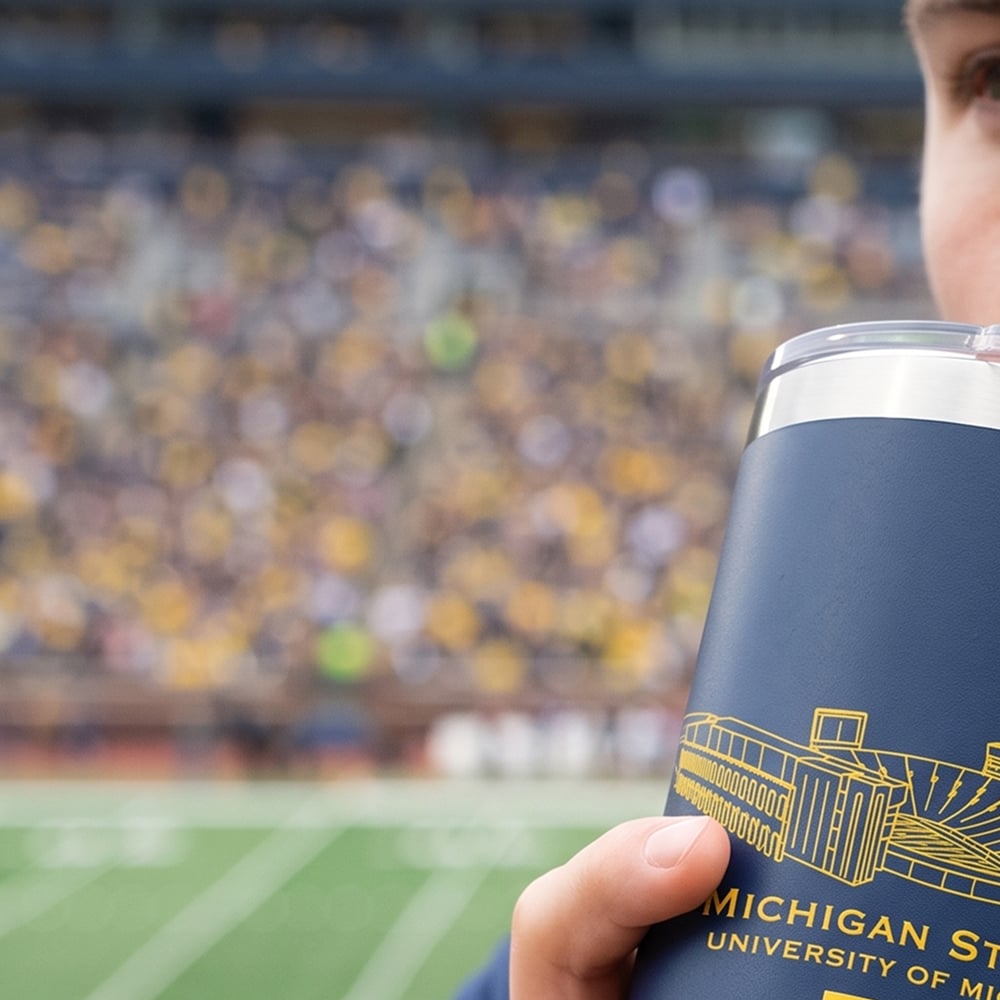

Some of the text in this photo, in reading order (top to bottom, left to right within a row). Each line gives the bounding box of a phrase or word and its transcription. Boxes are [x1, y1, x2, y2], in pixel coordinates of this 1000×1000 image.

[702, 888, 930, 952] MICHIGAN
[706, 931, 896, 978] UNIVERSITY
[906, 965, 951, 990] OF
